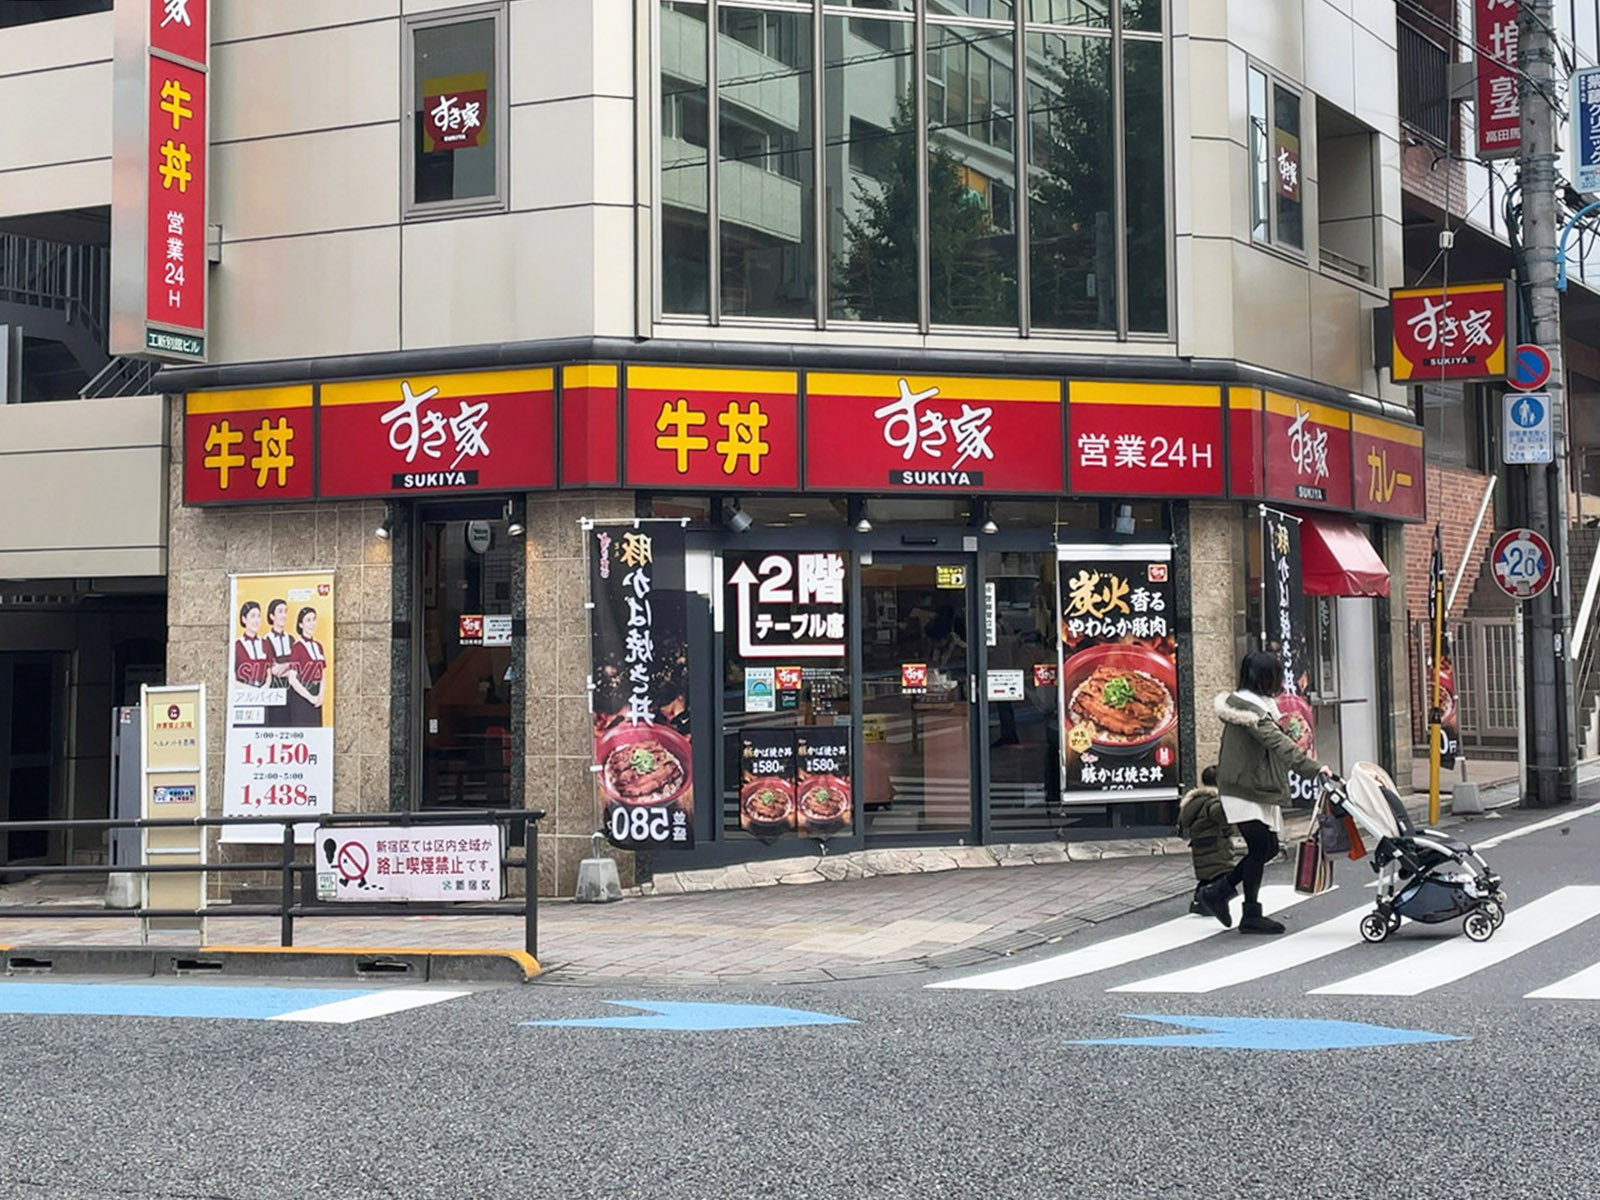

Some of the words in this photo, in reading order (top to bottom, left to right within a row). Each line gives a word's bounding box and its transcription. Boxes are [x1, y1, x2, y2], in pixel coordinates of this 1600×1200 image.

[431, 95, 480, 133] すき家
[160, 79, 193, 193] 牛丼
[1407, 298, 1492, 354] すき家
[1429, 356, 1469, 366] SUKIYA
[380, 381, 491, 470] すき家
[656, 398, 769, 475] 牛丼
[874, 379, 994, 470] すき家
[204, 417, 294, 489] 牛丼
[1078, 433, 1213, 470] 営業24H
[1288, 402, 1330, 487] すき家
[404, 472, 466, 487] SUKIYA
[902, 470, 971, 485] SUKIYA
[1367, 446, 1413, 503] カレー
[758, 554, 845, 604] 2階
[756, 613, 845, 639] テーブル席
[1068, 616, 1167, 638] やわらか豚肉
[241, 743, 317, 768] 1,150円
[1081, 765, 1164, 783] 豚かば焼き丼
[240, 784, 317, 809] 1,438円
